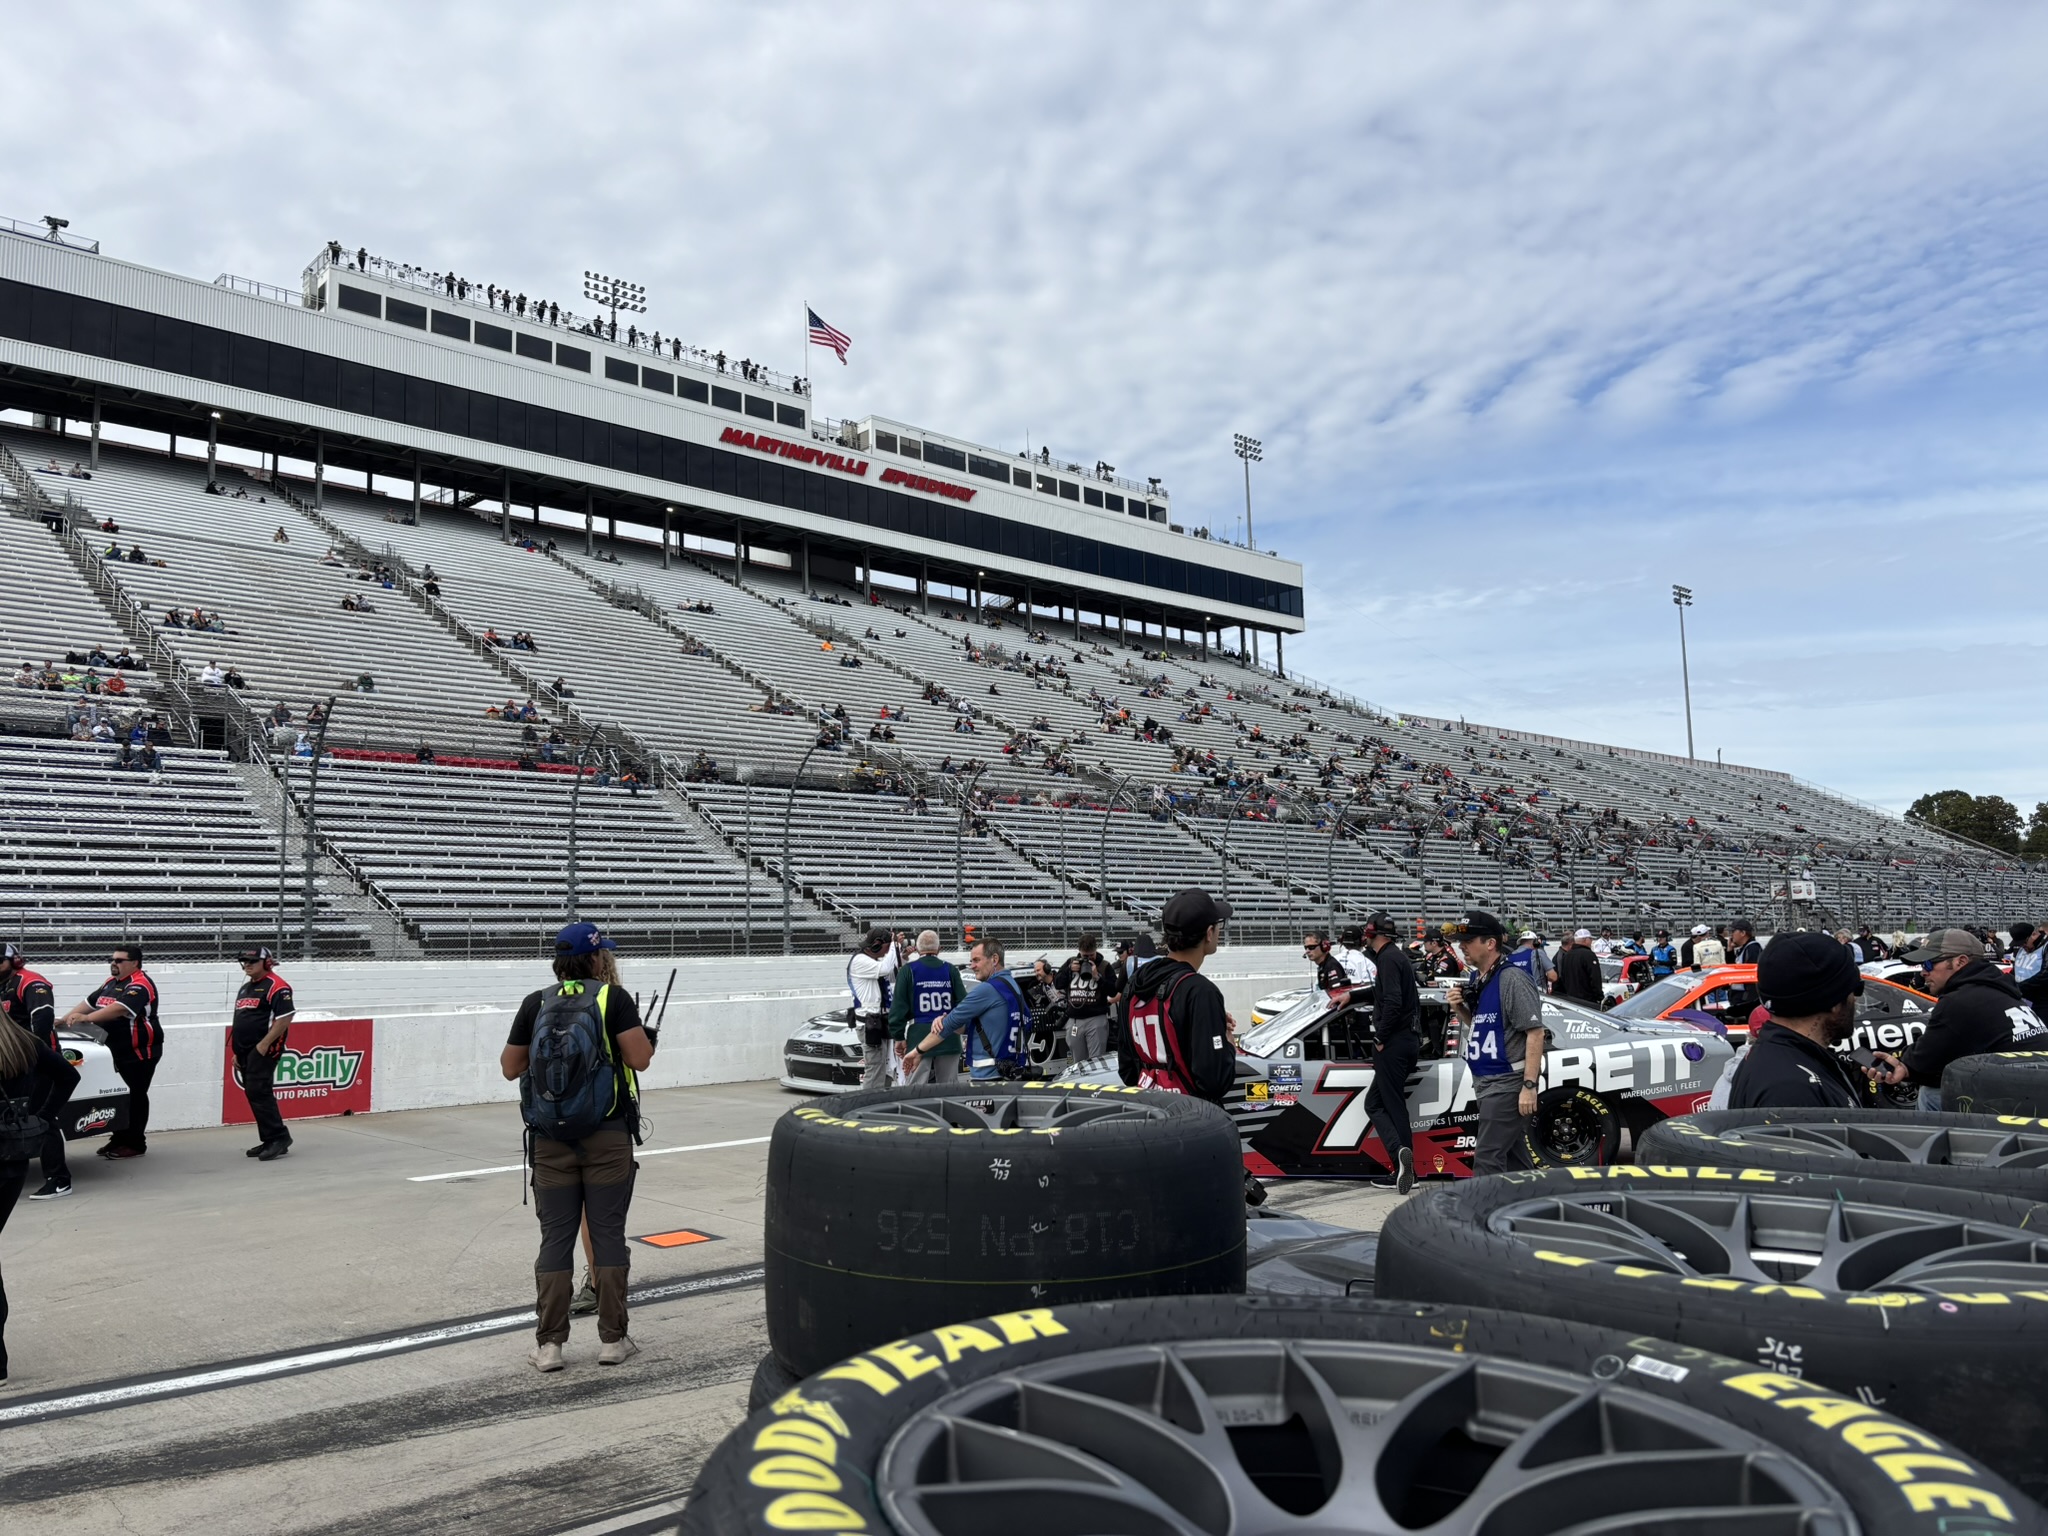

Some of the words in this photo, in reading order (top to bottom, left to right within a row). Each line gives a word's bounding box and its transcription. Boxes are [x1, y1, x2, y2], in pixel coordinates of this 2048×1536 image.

[719, 427, 868, 476] MARTINSVILLE
[880, 467, 977, 502] SPEEDWAY
[919, 992, 952, 1013] 603
[1563, 1019, 1602, 1034] Tufco
[276, 1053, 355, 1083] Reilly
[1419, 1038, 1703, 1116] JARETT
[274, 1089, 295, 1100] UTO
[297, 1087, 328, 1099] PARTS
[1576, 1091, 1609, 1115] EAGLE
[1620, 1085, 1673, 1100] WAREHOUSING
[1680, 1080, 1702, 1090] FLEET
[1317, 1067, 1375, 1150] 7
[1696, 1102, 1710, 1113] HE
[1410, 1118, 1446, 1128] LOGISTICS
[1565, 1165, 1777, 1182] EAGLE
[877, 1209, 950, 1255] 526
[980, 1213, 1035, 1256] PN
[1065, 1209, 1140, 1255] C18
[818, 1308, 1070, 1396] YEAR
[1723, 1371, 2016, 1524] EAGLE
